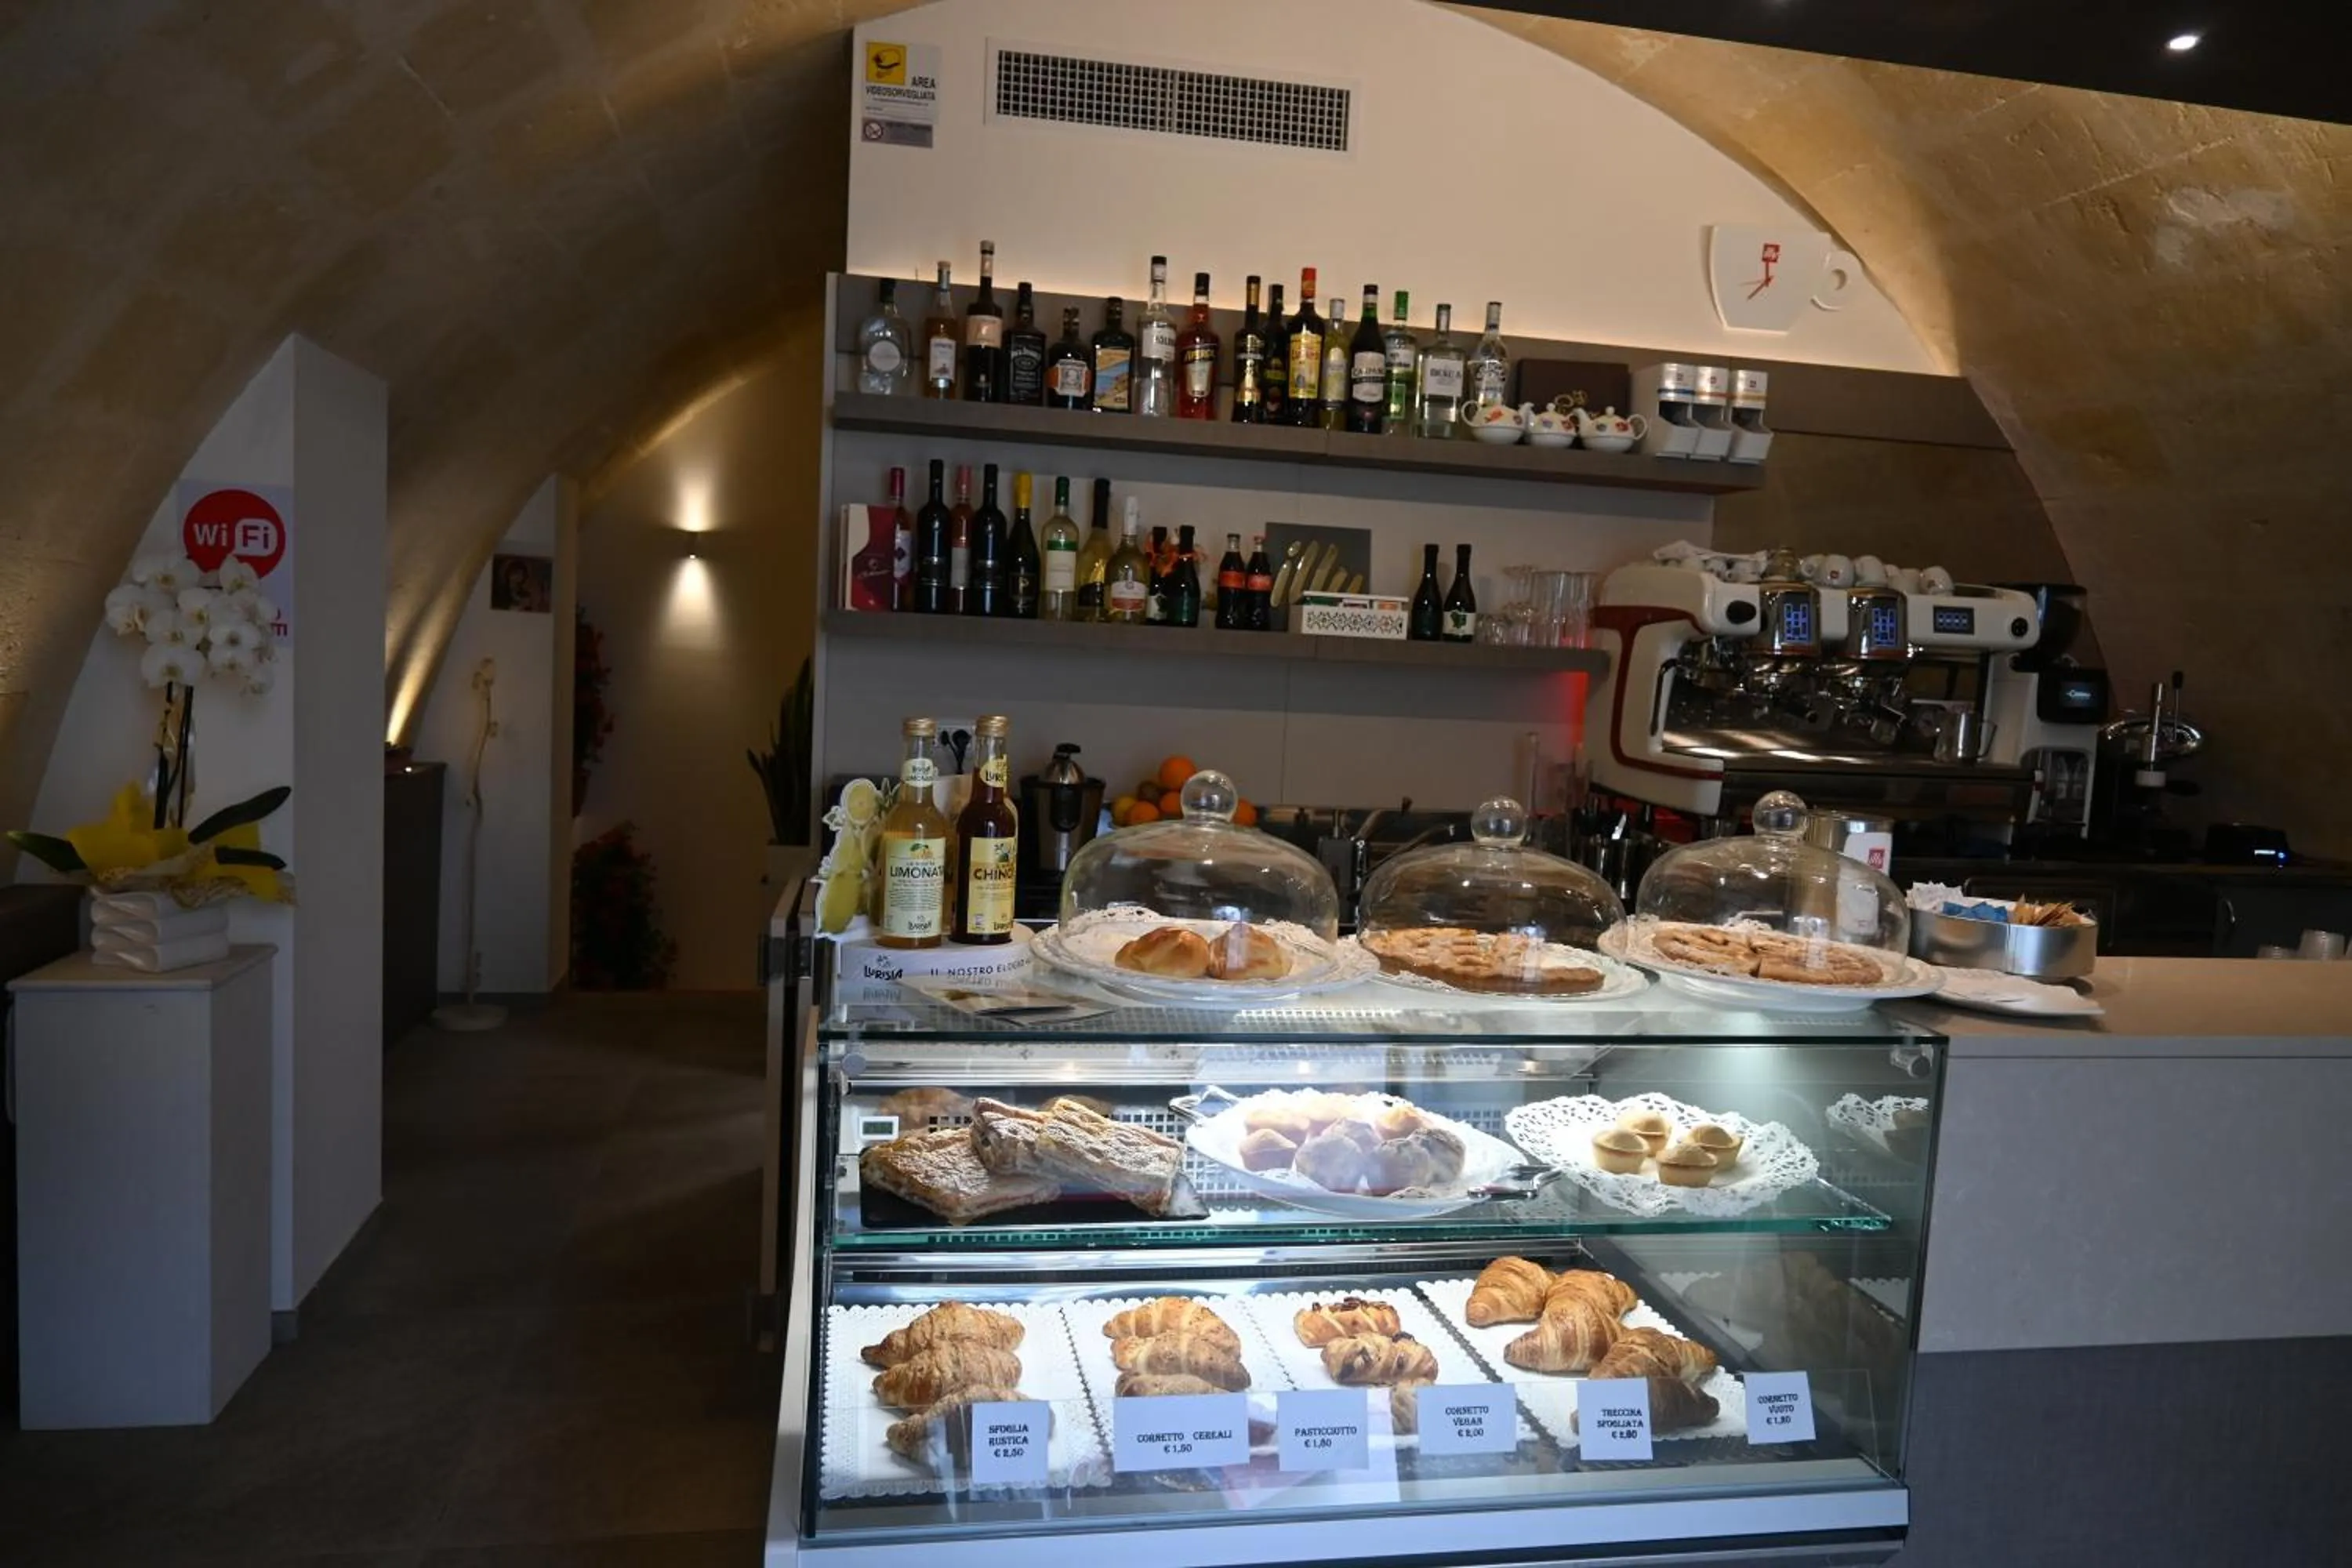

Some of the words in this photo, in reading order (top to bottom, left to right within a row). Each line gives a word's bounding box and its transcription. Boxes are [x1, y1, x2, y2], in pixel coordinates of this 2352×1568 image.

[911, 77, 936, 89] AREA
[864, 965, 903, 980] LURISIA
[948, 965, 994, 977] NOSTRO
[1758, 1393, 1798, 1404] CORNETTO
[1445, 1406, 1489, 1415] CORNETTO
[1601, 1408, 1642, 1417] TRECCINA
[1453, 1417, 1483, 1426] VEGAN
[1596, 1420, 1644, 1428] SFOGLIATA
[989, 1424, 1029, 1434] SFOGLIA
[1294, 1426, 1357, 1436] PASTICCIOTTO
[989, 1436, 1029, 1446] RUSTICA
[1137, 1432, 1185, 1443] CORNETTO
[1192, 1430, 1232, 1440] CEREALI
